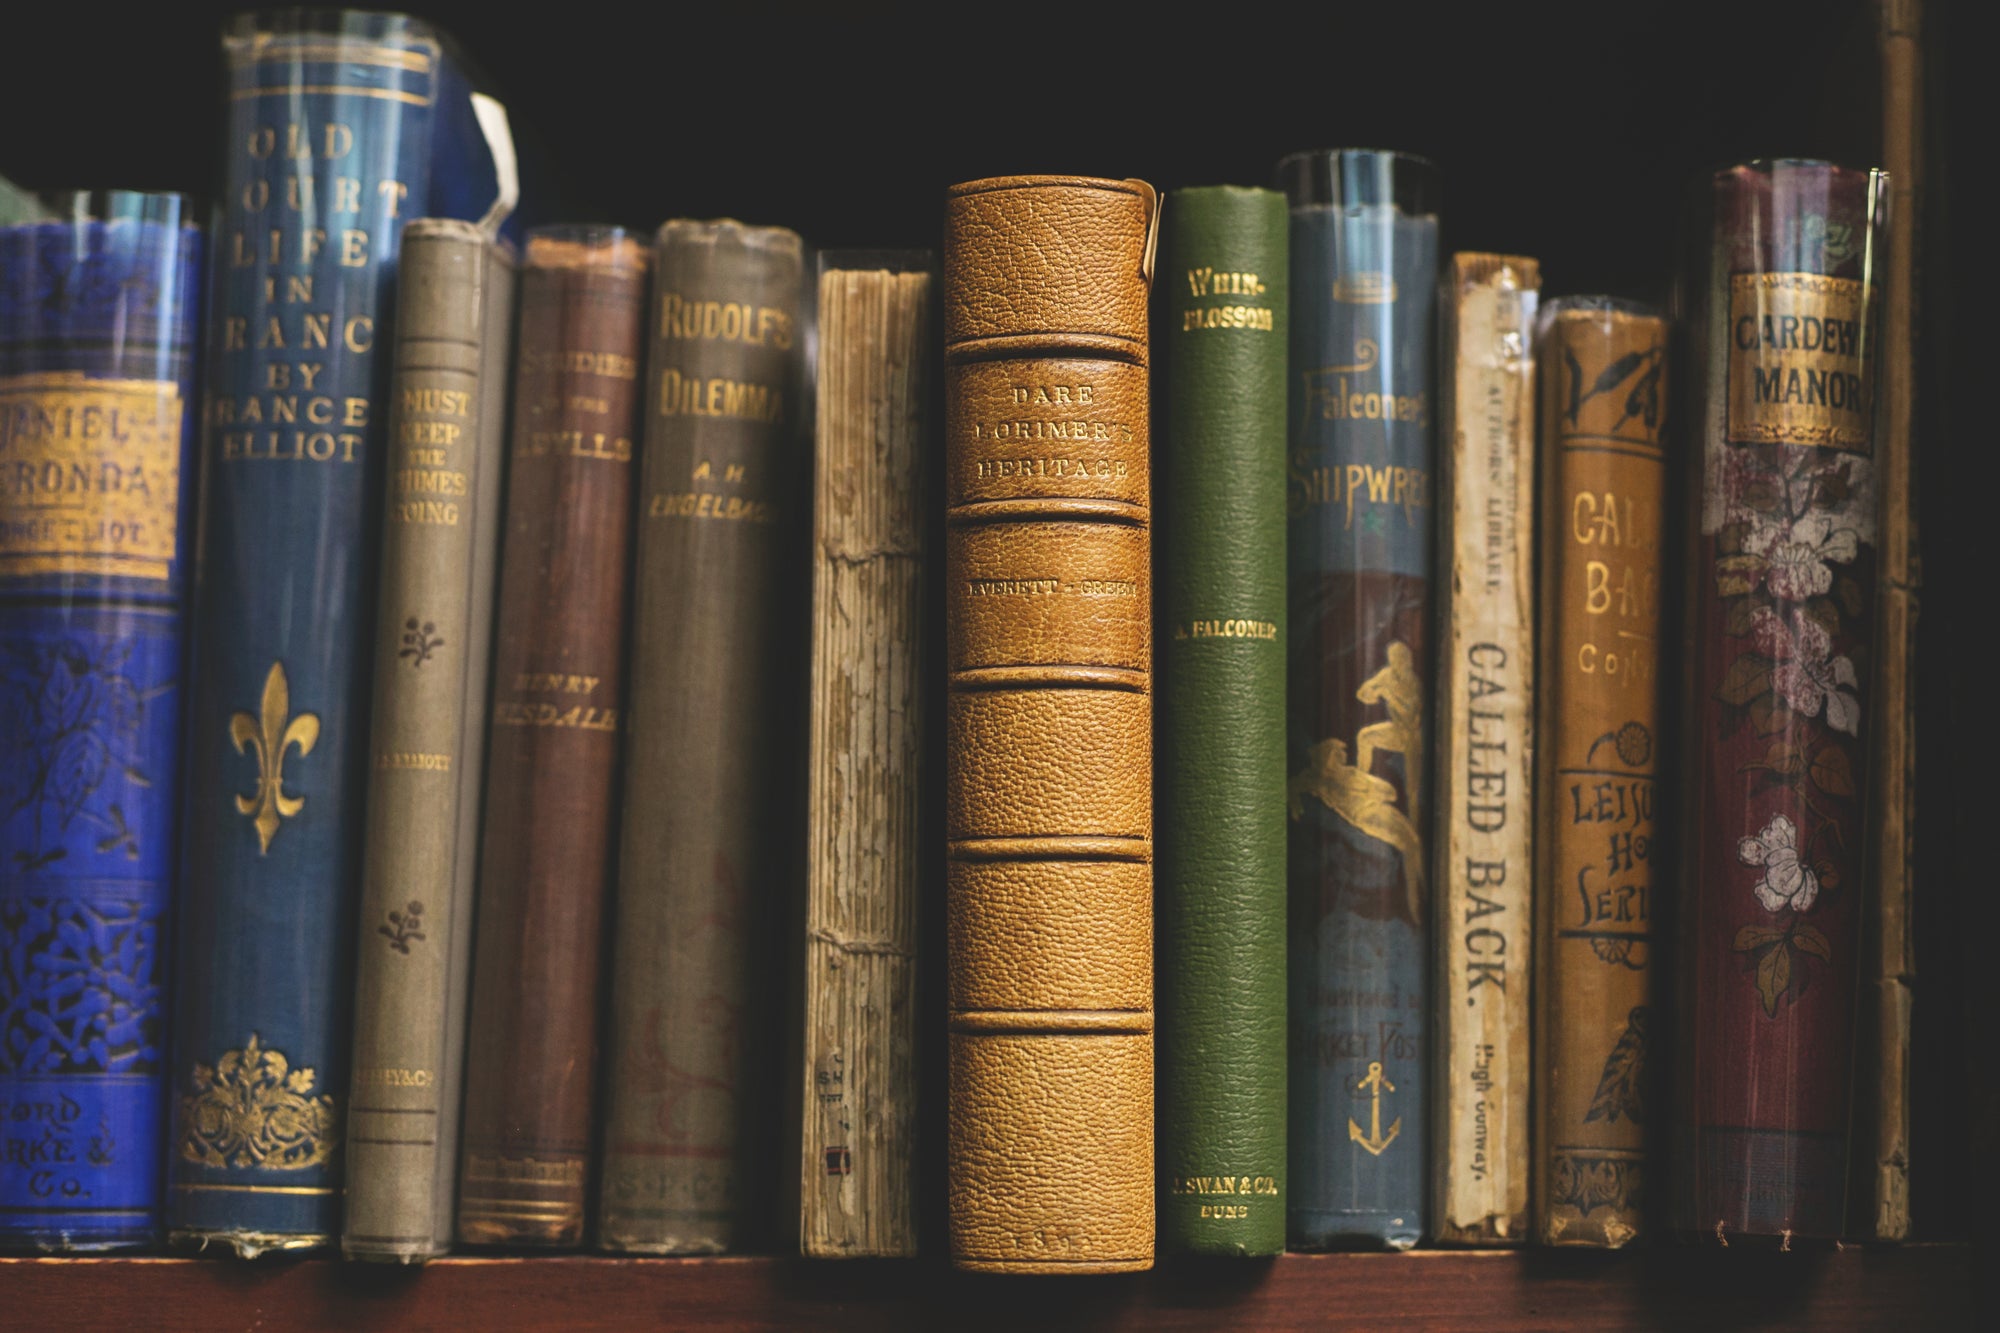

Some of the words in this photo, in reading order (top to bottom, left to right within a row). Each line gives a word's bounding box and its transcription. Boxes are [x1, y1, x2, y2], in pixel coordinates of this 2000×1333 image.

[248, 123, 353, 160] OLD
[243, 176, 408, 219] OURT
[232, 230, 369, 268] LIFE
[265, 275, 313, 303] IN
[226, 314, 374, 354] RANC
[267, 363, 321, 390] BY
[1753, 366, 1864, 412] MANOR
[216, 396, 370, 428] RANCE
[1013, 385, 1094, 405] DARE
[0, 405, 130, 442] ANIEL
[975, 420, 1133, 442] LORIMER'S
[223, 432, 364, 462] ELLIOT
[0, 461, 151, 497] RONDA
[977, 458, 1129, 479] HERITAGE
[400, 500, 459, 526] OING
[1192, 619, 1278, 641] FALCONER
[1467, 641, 1508, 834] CALLED
[1606, 831, 1650, 877] HO
[1577, 863, 1648, 928] SERI
[1465, 856, 1508, 1007] BACK.
[0, 1128, 76, 1170] RKE
[1200, 1205, 1249, 1219] DUNS
